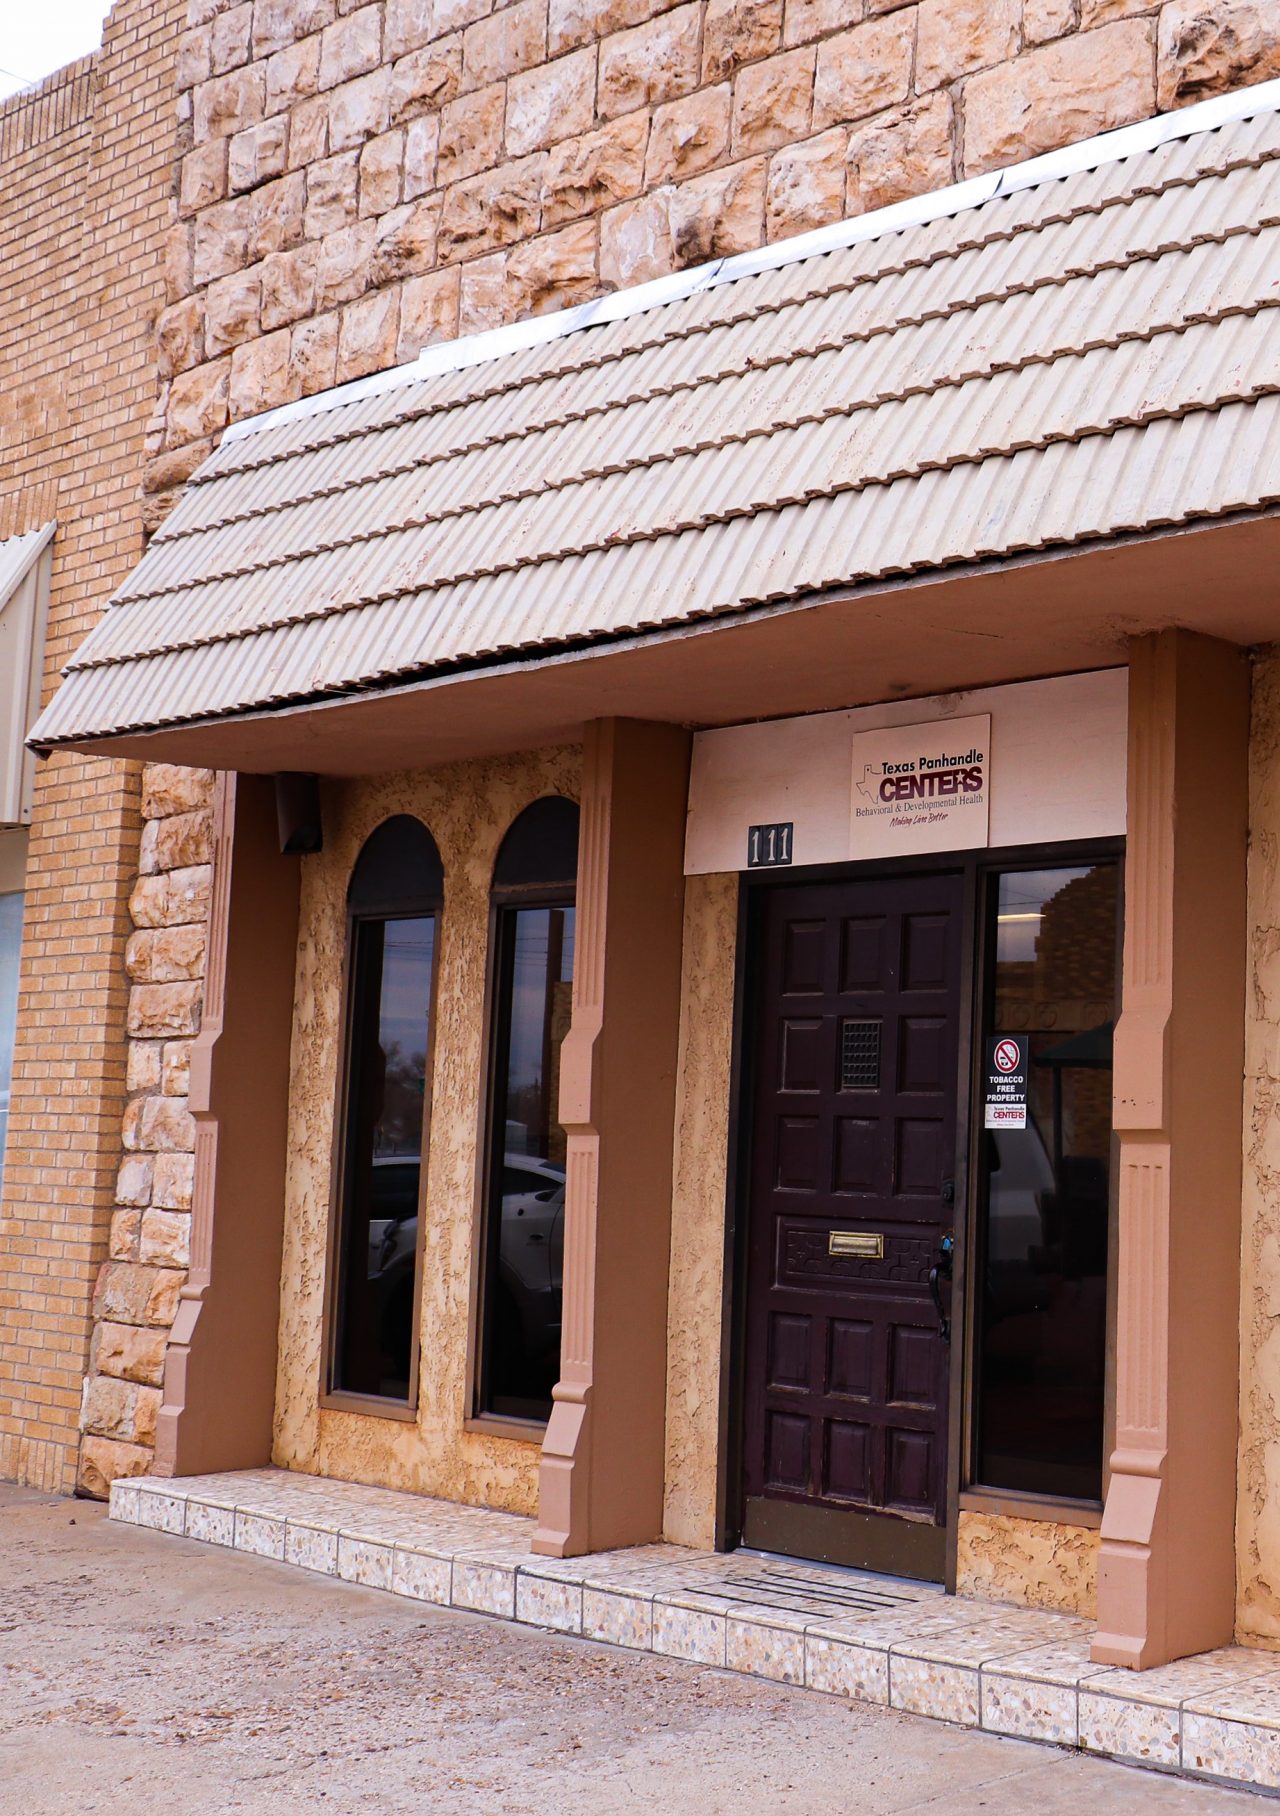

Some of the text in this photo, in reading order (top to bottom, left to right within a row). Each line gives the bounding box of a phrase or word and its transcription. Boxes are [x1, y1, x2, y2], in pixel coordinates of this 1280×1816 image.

[882, 749, 984, 775] Texas Panhandle
[879, 766, 983, 802] CENTERS
[856, 794, 984, 817] Behavioral & Developmental Health
[889, 812, 949, 827] Making Lives Better
[752, 827, 789, 863] 111
[989, 1076, 1024, 1084] TOBACCO
[996, 1085, 1016, 1093] FREE
[986, 1094, 1025, 1102] PROPERTY
[993, 1111, 1025, 1119] CENTERS
